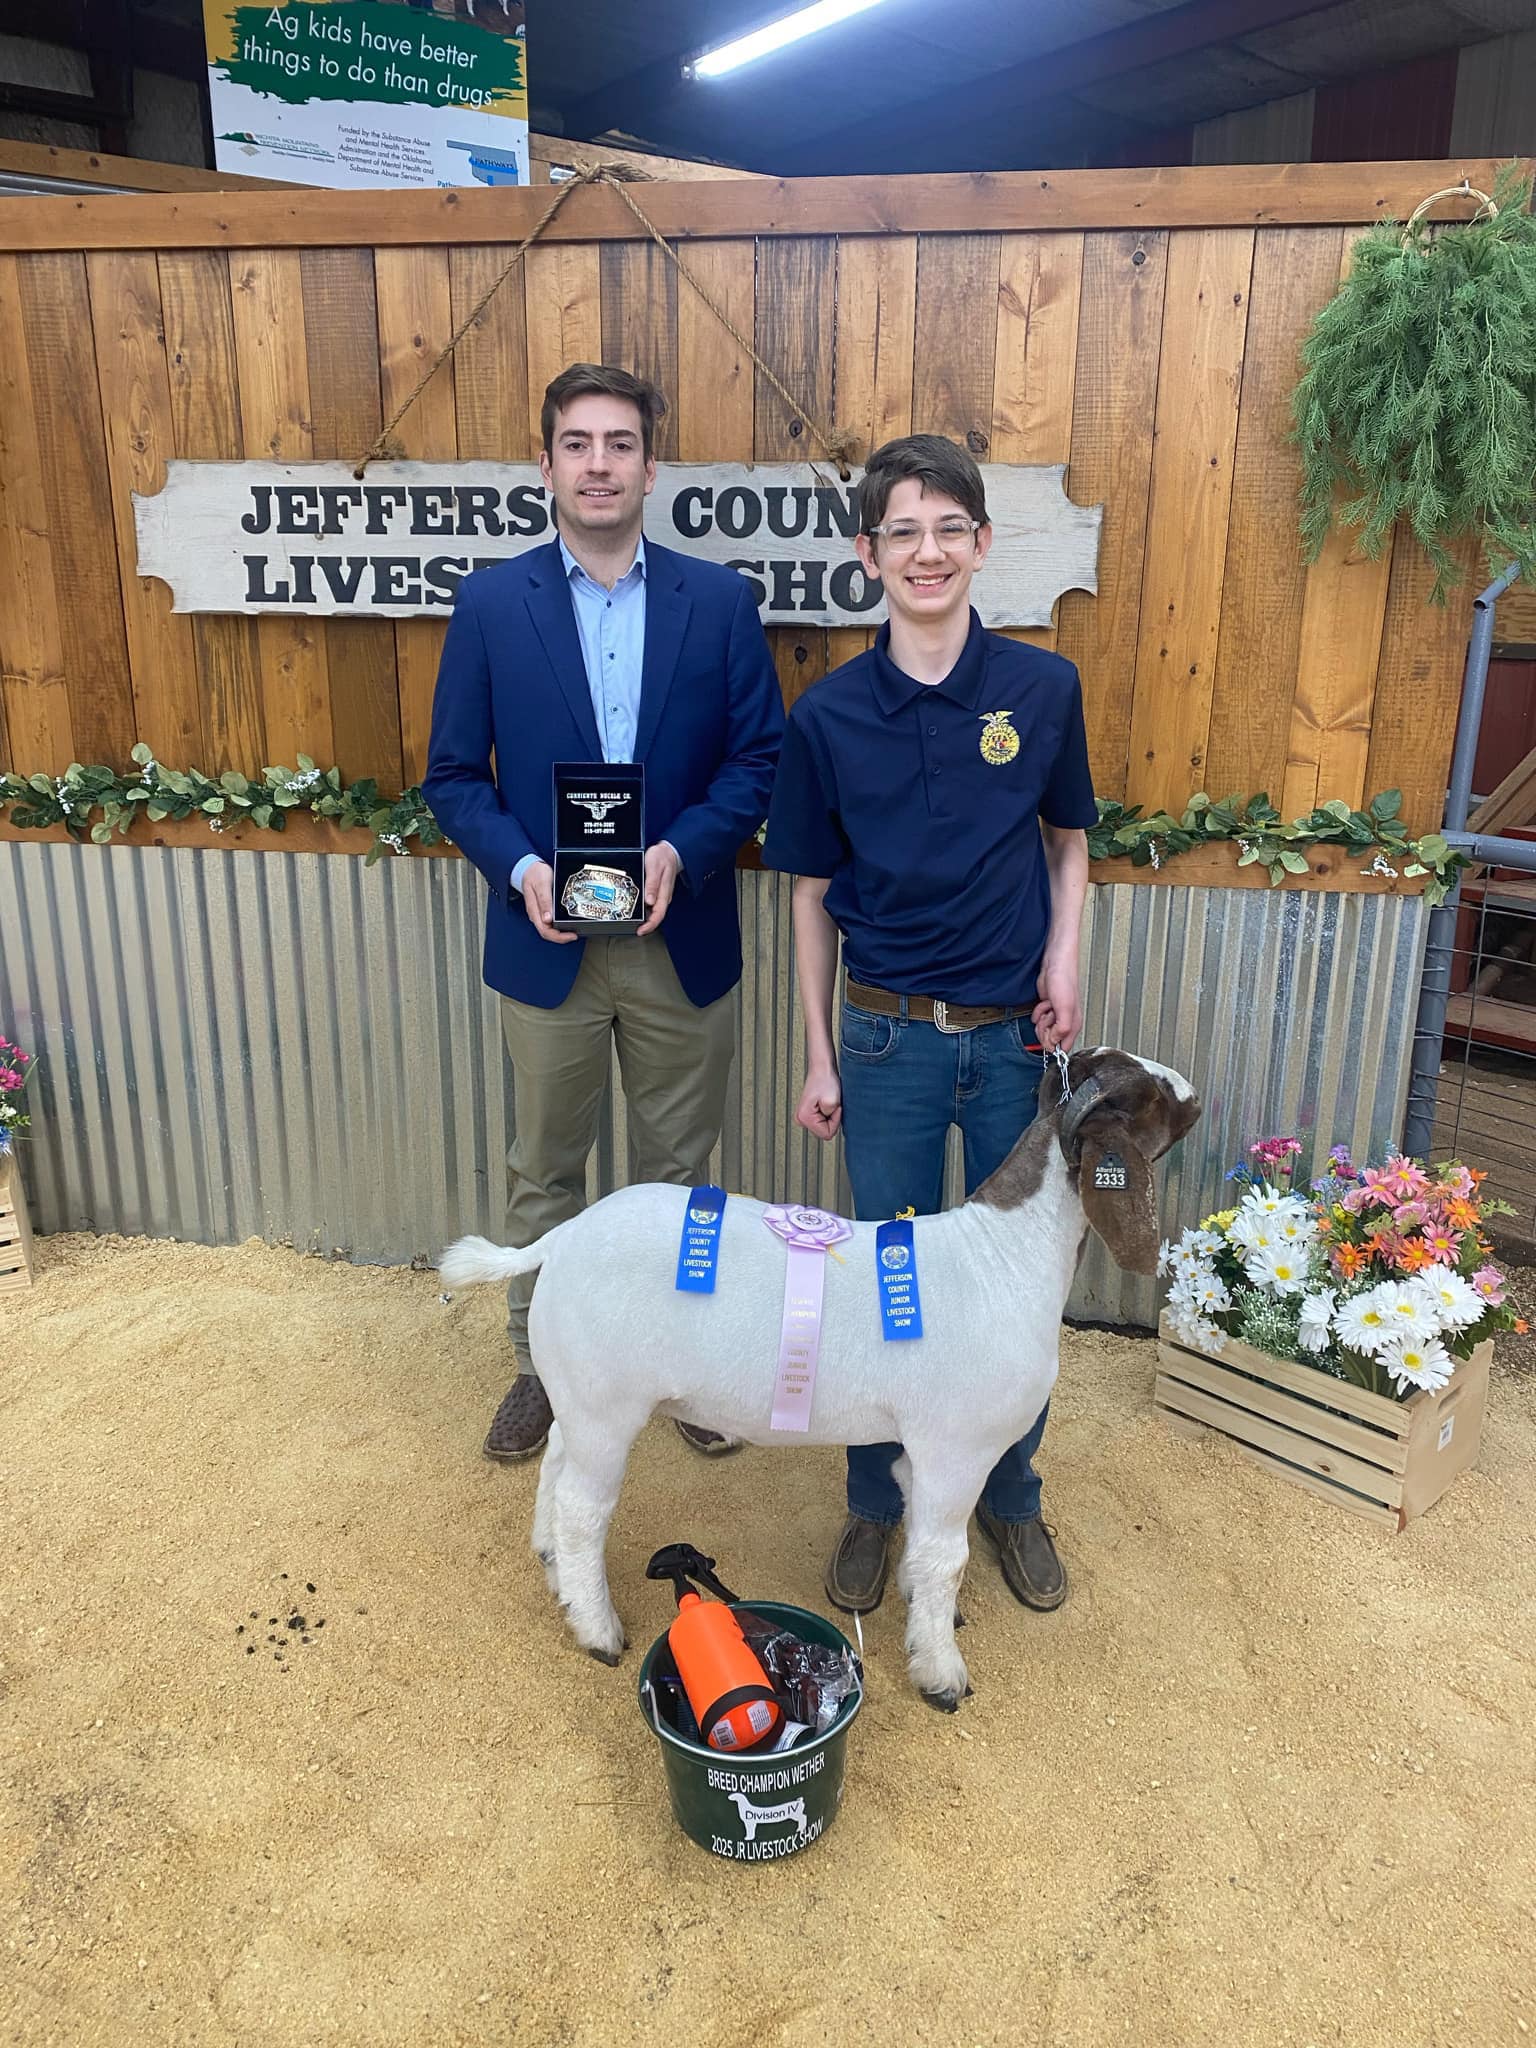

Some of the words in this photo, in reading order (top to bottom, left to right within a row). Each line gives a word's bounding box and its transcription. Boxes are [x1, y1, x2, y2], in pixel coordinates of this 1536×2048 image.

[265, 5, 299, 40] Ag
[309, 10, 352, 44] kids
[361, 21, 412, 56] have
[420, 33, 478, 69] better
[244, 34, 311, 76] things
[320, 53, 340, 77] to
[347, 55, 376, 84] do
[385, 62, 429, 95] than
[437, 73, 498, 110] drugs.
[337, 124, 361, 135] Funded
[361, 128, 370, 137] by
[371, 129, 380, 138] the
[381, 132, 411, 144] Substance
[412, 137, 431, 147] Abuse
[345, 136, 358, 144] and
[359, 138, 380, 148] Mental
[380, 141, 400, 151] Health
[401, 145, 425, 156] Services
[378, 151, 390, 159] and
[391, 152, 400, 160] the
[337, 152, 372, 165] Department
[380, 160, 401, 169] Mental
[402, 163, 421, 173] Health
[475, 157, 514, 169] PATHWAYS
[349, 163, 380, 176] Substance
[381, 169, 399, 178] Abuse
[400, 171, 424, 182] Services
[241, 485, 559, 537] JEFFERS
[672, 486, 861, 538] COUN
[243, 555, 513, 605] LIVES
[723, 559, 885, 613] SHO
[1095, 1173, 1125, 1185] 2333
[686, 1227, 716, 1236] JEFFERSON
[689, 1238, 711, 1246] COUNTY
[689, 1248, 709, 1256] JUNIOR
[683, 1258, 712, 1268] LIVESTOCK
[688, 1270, 706, 1278] SHOW
[883, 1273, 913, 1284] JEFFERSON
[888, 1284, 910, 1294] COUNTY
[890, 1295, 910, 1305] JUNIOR
[886, 1306, 916, 1316] LIVESTOCK
[894, 1318, 911, 1327] SHOW
[707, 1768, 738, 1792] BREED
[740, 1769, 790, 1793] CHAMPION
[791, 1751, 825, 1784] WETHER
[745, 1809, 785, 1820] Division
[788, 1803, 799, 1815] IV
[711, 1835, 733, 1858] 2025
[735, 1841, 746, 1860] JR
[747, 1833, 798, 1860] LIVESTOCK
[799, 1816, 824, 1848] SHOW
